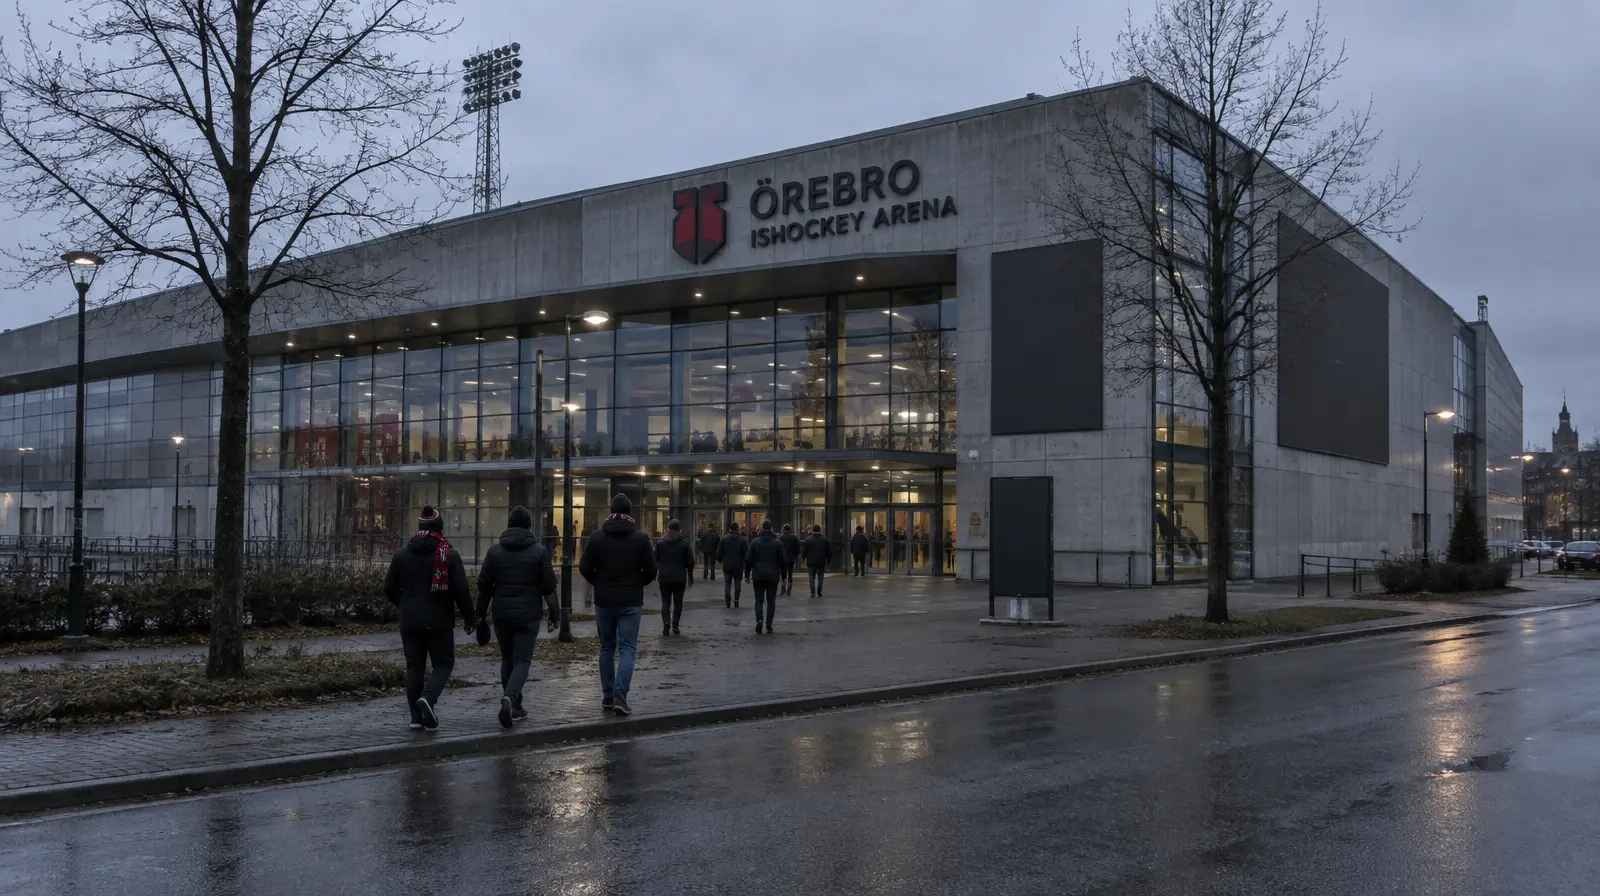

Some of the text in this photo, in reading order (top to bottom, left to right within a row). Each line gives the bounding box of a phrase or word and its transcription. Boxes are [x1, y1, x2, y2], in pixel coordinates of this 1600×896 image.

[750, 159, 920, 220] ÖREBRO
[751, 195, 958, 249] ISHOCKEY ARENA
